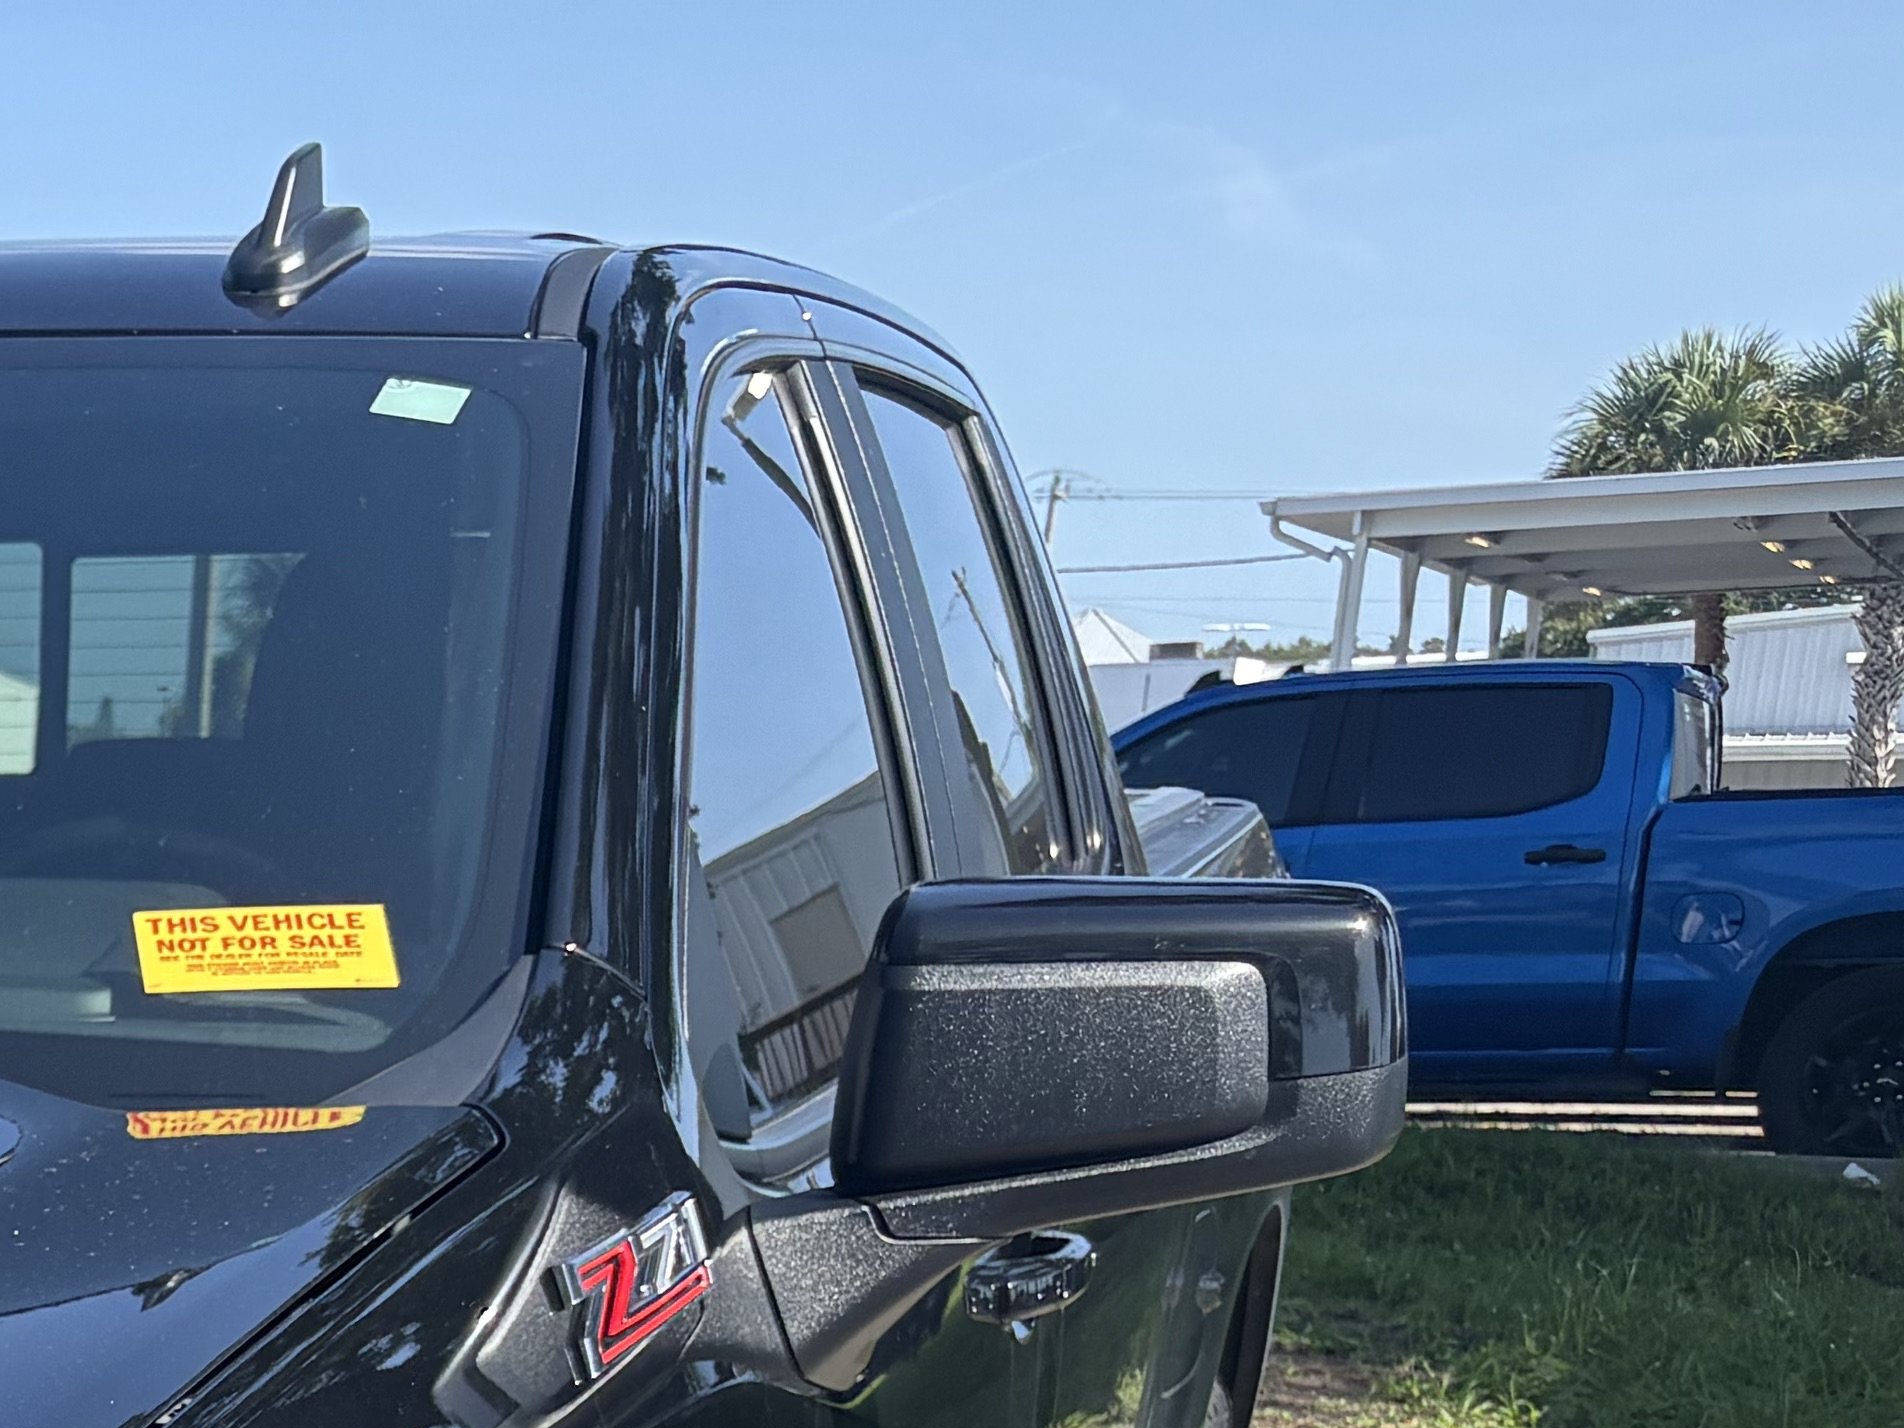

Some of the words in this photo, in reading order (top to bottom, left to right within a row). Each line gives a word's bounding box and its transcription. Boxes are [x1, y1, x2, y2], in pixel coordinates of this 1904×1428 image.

[145, 915, 221, 935] THIS
[228, 911, 366, 932] VEHICLE
[156, 936, 211, 954] NOT
[221, 935, 278, 951] FOR
[289, 933, 362, 949] SALE
[575, 1195, 713, 1370] Z71
